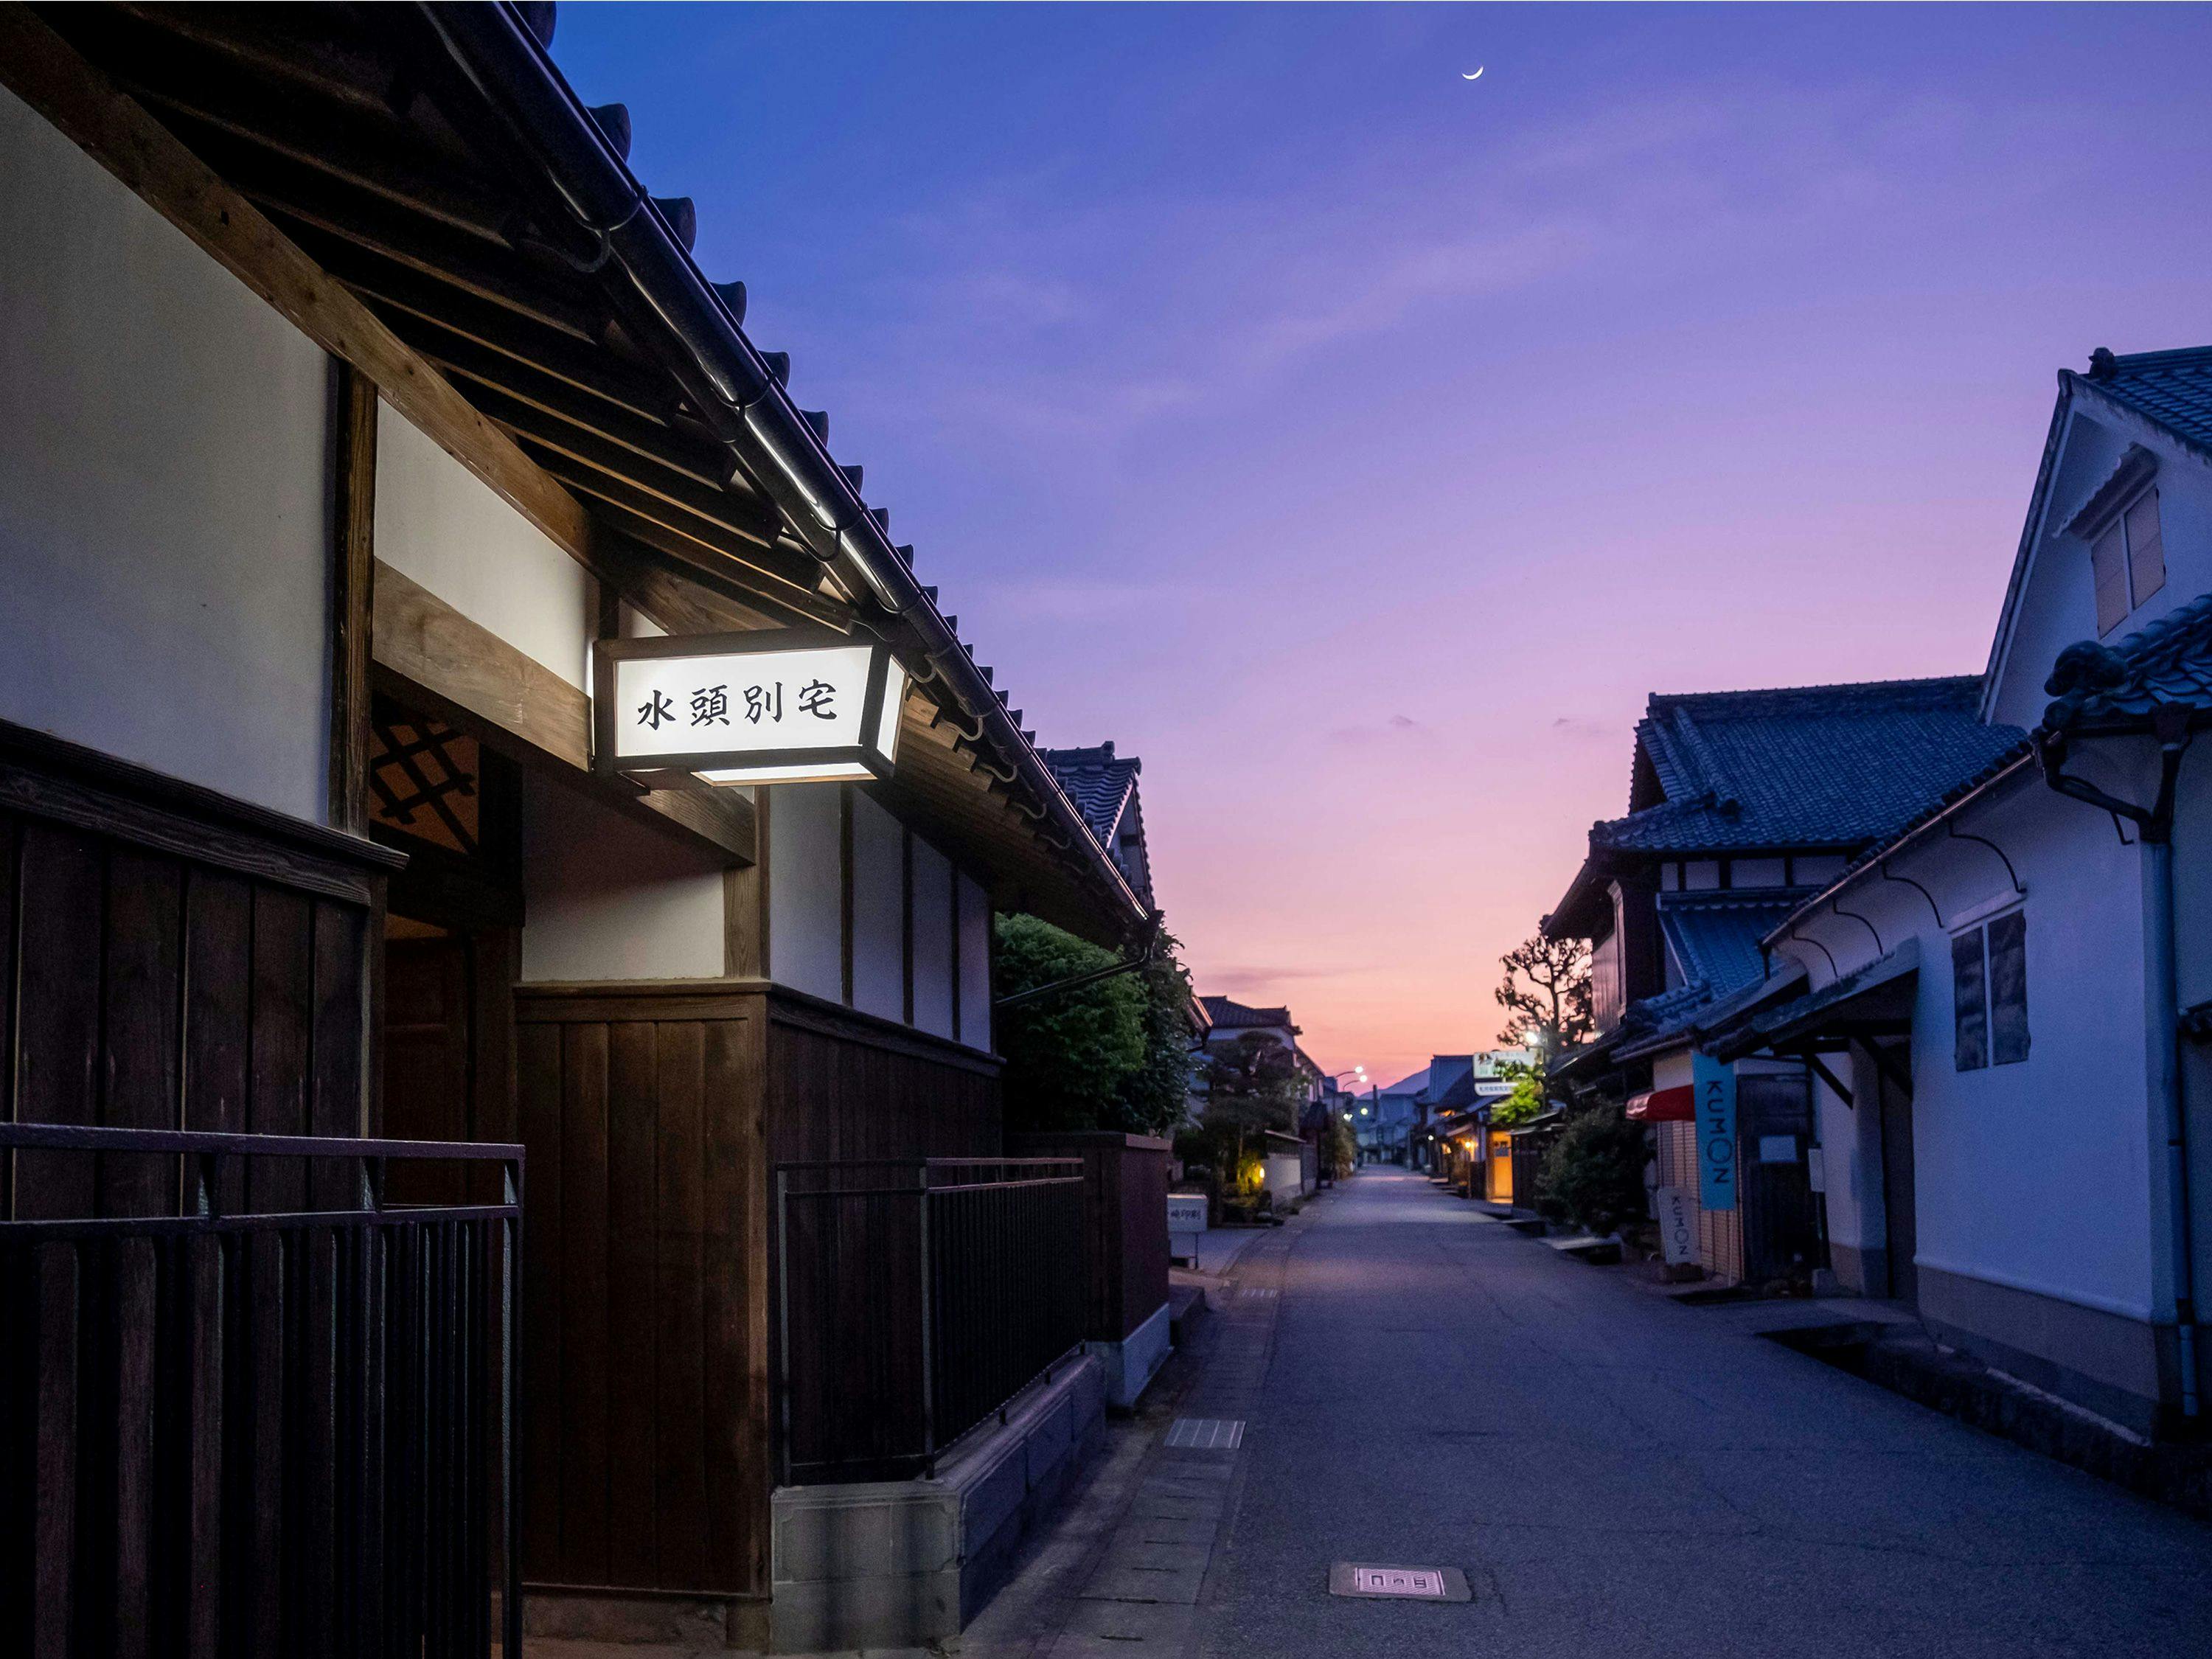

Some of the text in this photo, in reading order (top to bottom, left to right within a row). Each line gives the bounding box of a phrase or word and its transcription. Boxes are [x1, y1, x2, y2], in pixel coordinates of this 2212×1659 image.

[637, 678, 837, 731] 水頭別宅
[1707, 1080, 1733, 1184] KUMON
[1672, 1195, 1689, 1255] KUMON
